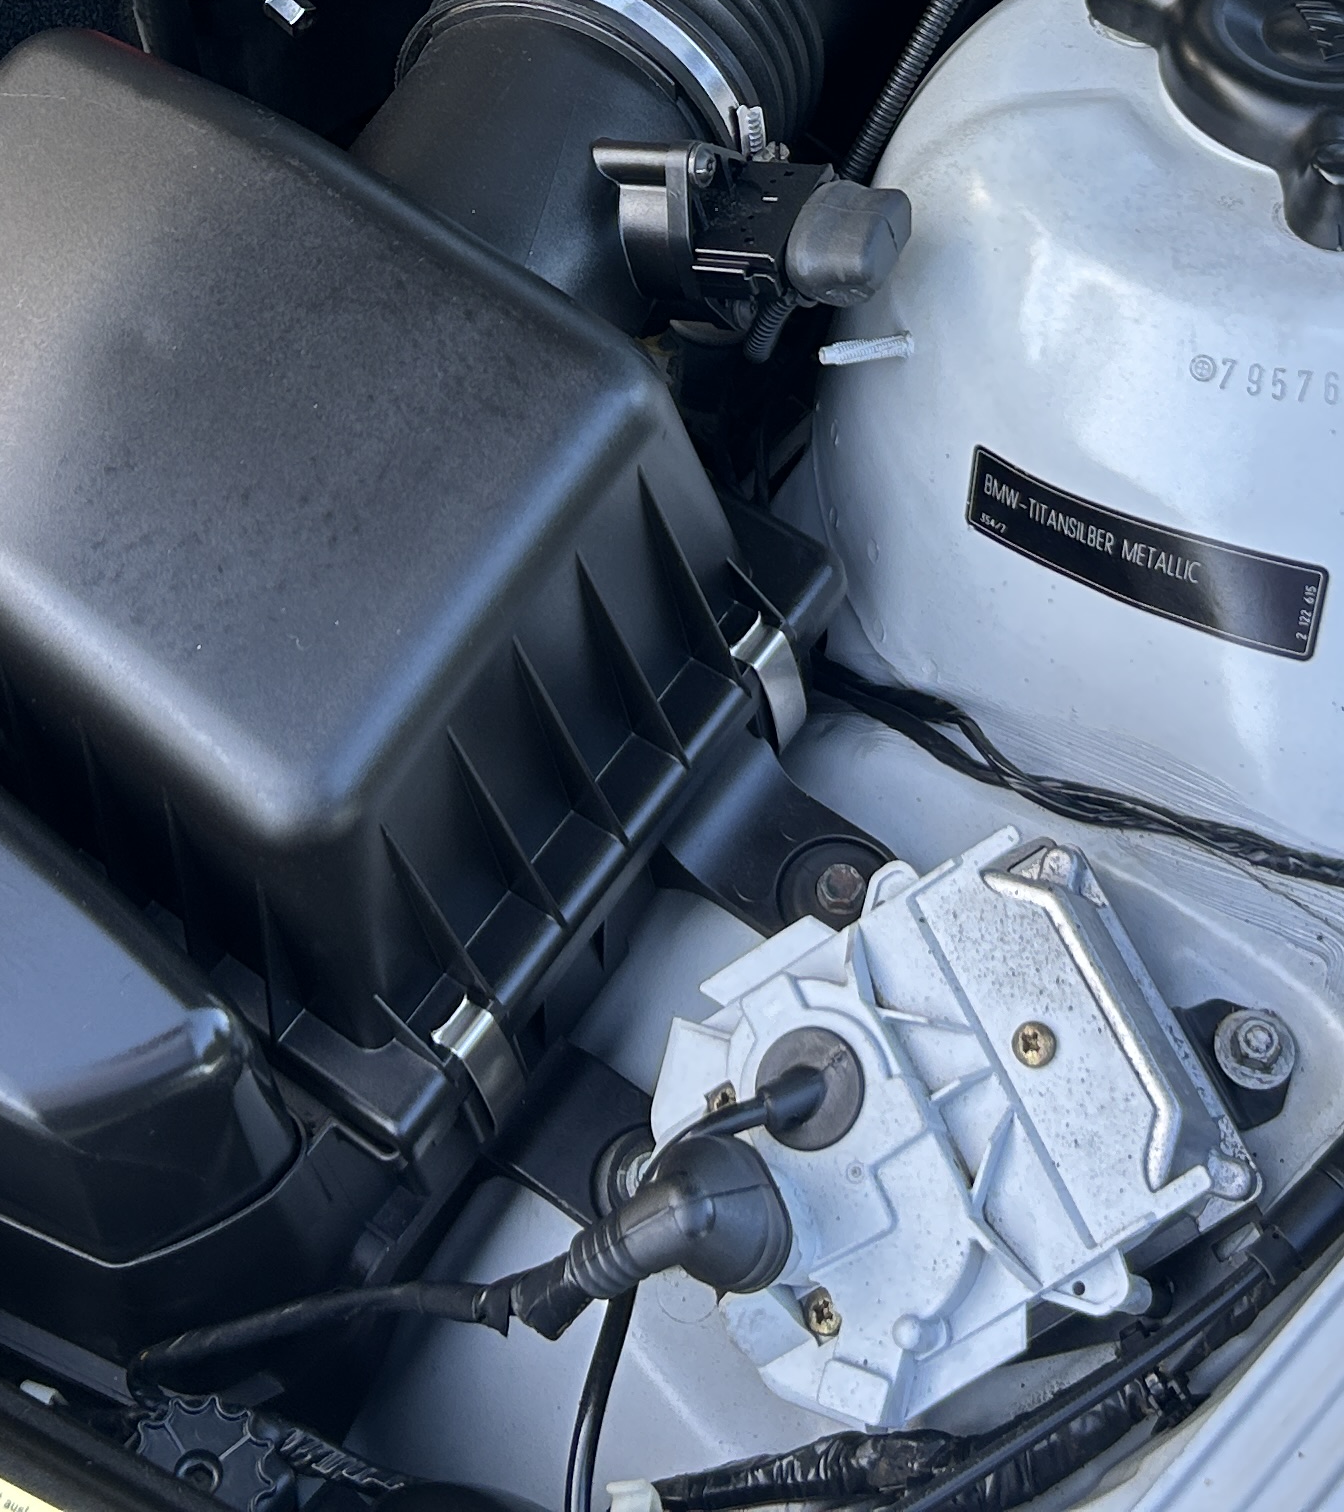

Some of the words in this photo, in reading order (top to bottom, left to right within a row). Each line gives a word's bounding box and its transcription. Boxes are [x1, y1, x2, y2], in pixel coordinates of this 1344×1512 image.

[984, 473, 1115, 555] BMW-TITANSILBER
[1121, 538, 1202, 584] METALLIC
[1302, 585, 1317, 604] 615
[1298, 609, 1312, 626] 122
[1295, 631, 1308, 641] 2
